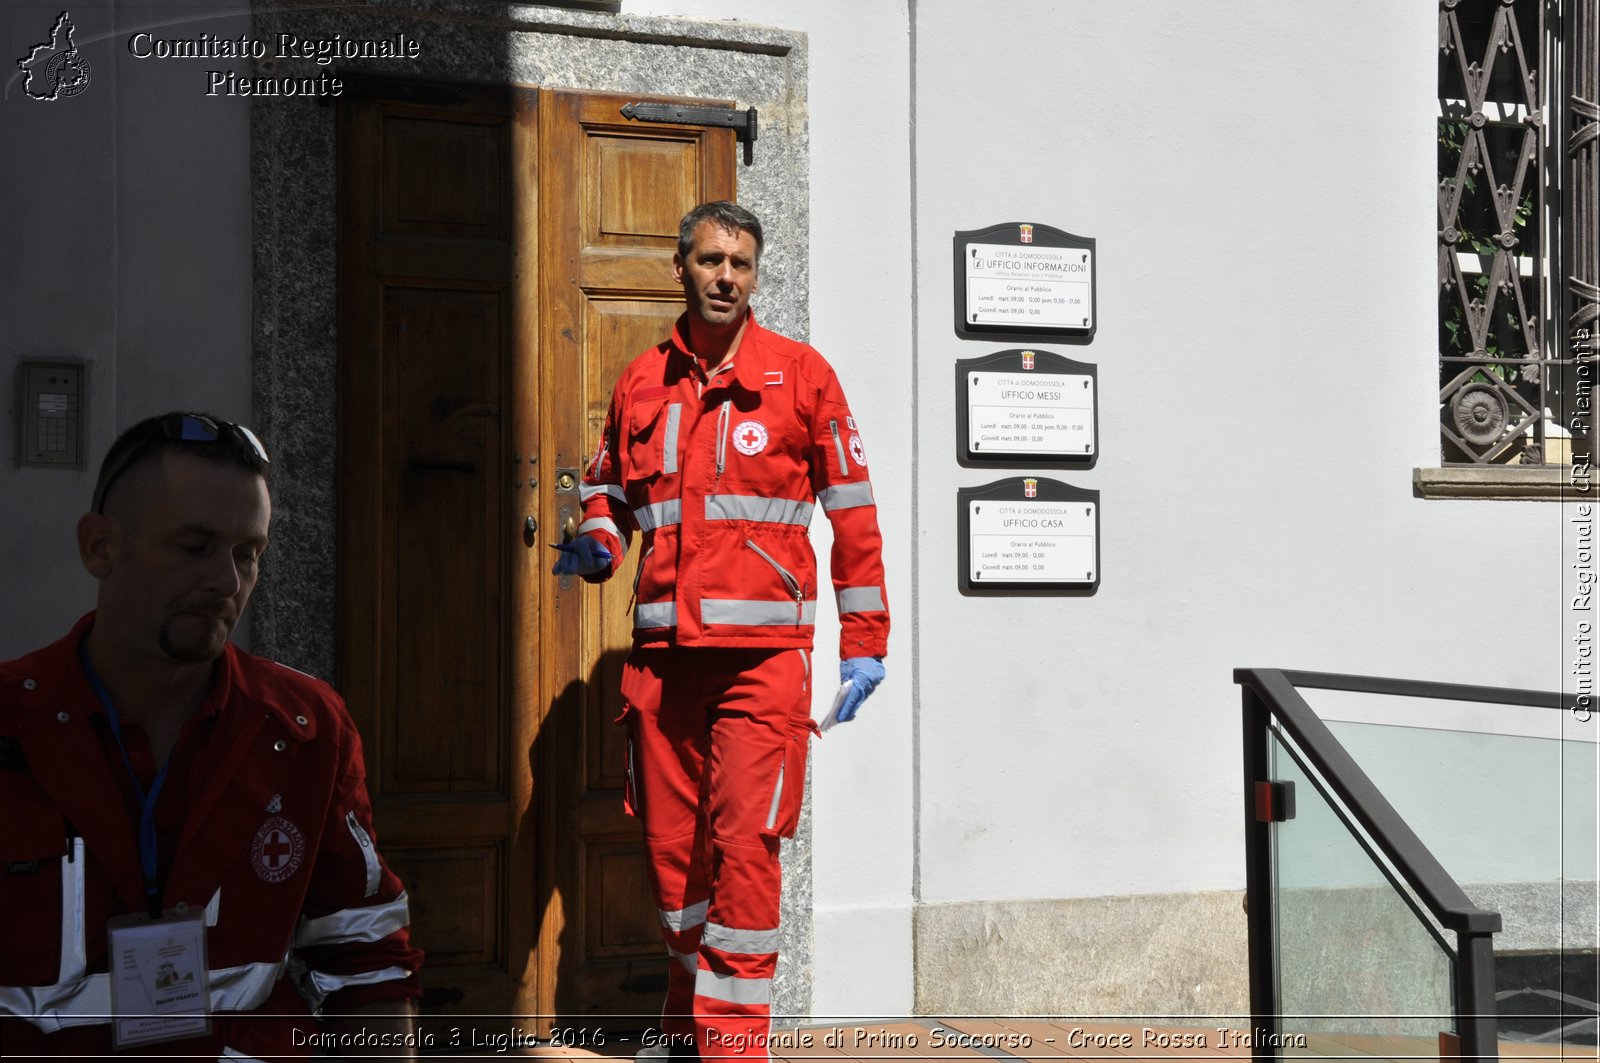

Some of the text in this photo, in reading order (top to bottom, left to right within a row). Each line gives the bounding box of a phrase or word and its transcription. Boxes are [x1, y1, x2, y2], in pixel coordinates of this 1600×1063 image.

[986, 260, 1022, 270] UFFICIO
[1024, 262, 1086, 273] INFORMAZIONI
[1001, 390, 1061, 400] UFFICIO MESSI
[1003, 519, 1064, 528] UFFICIO CASA
